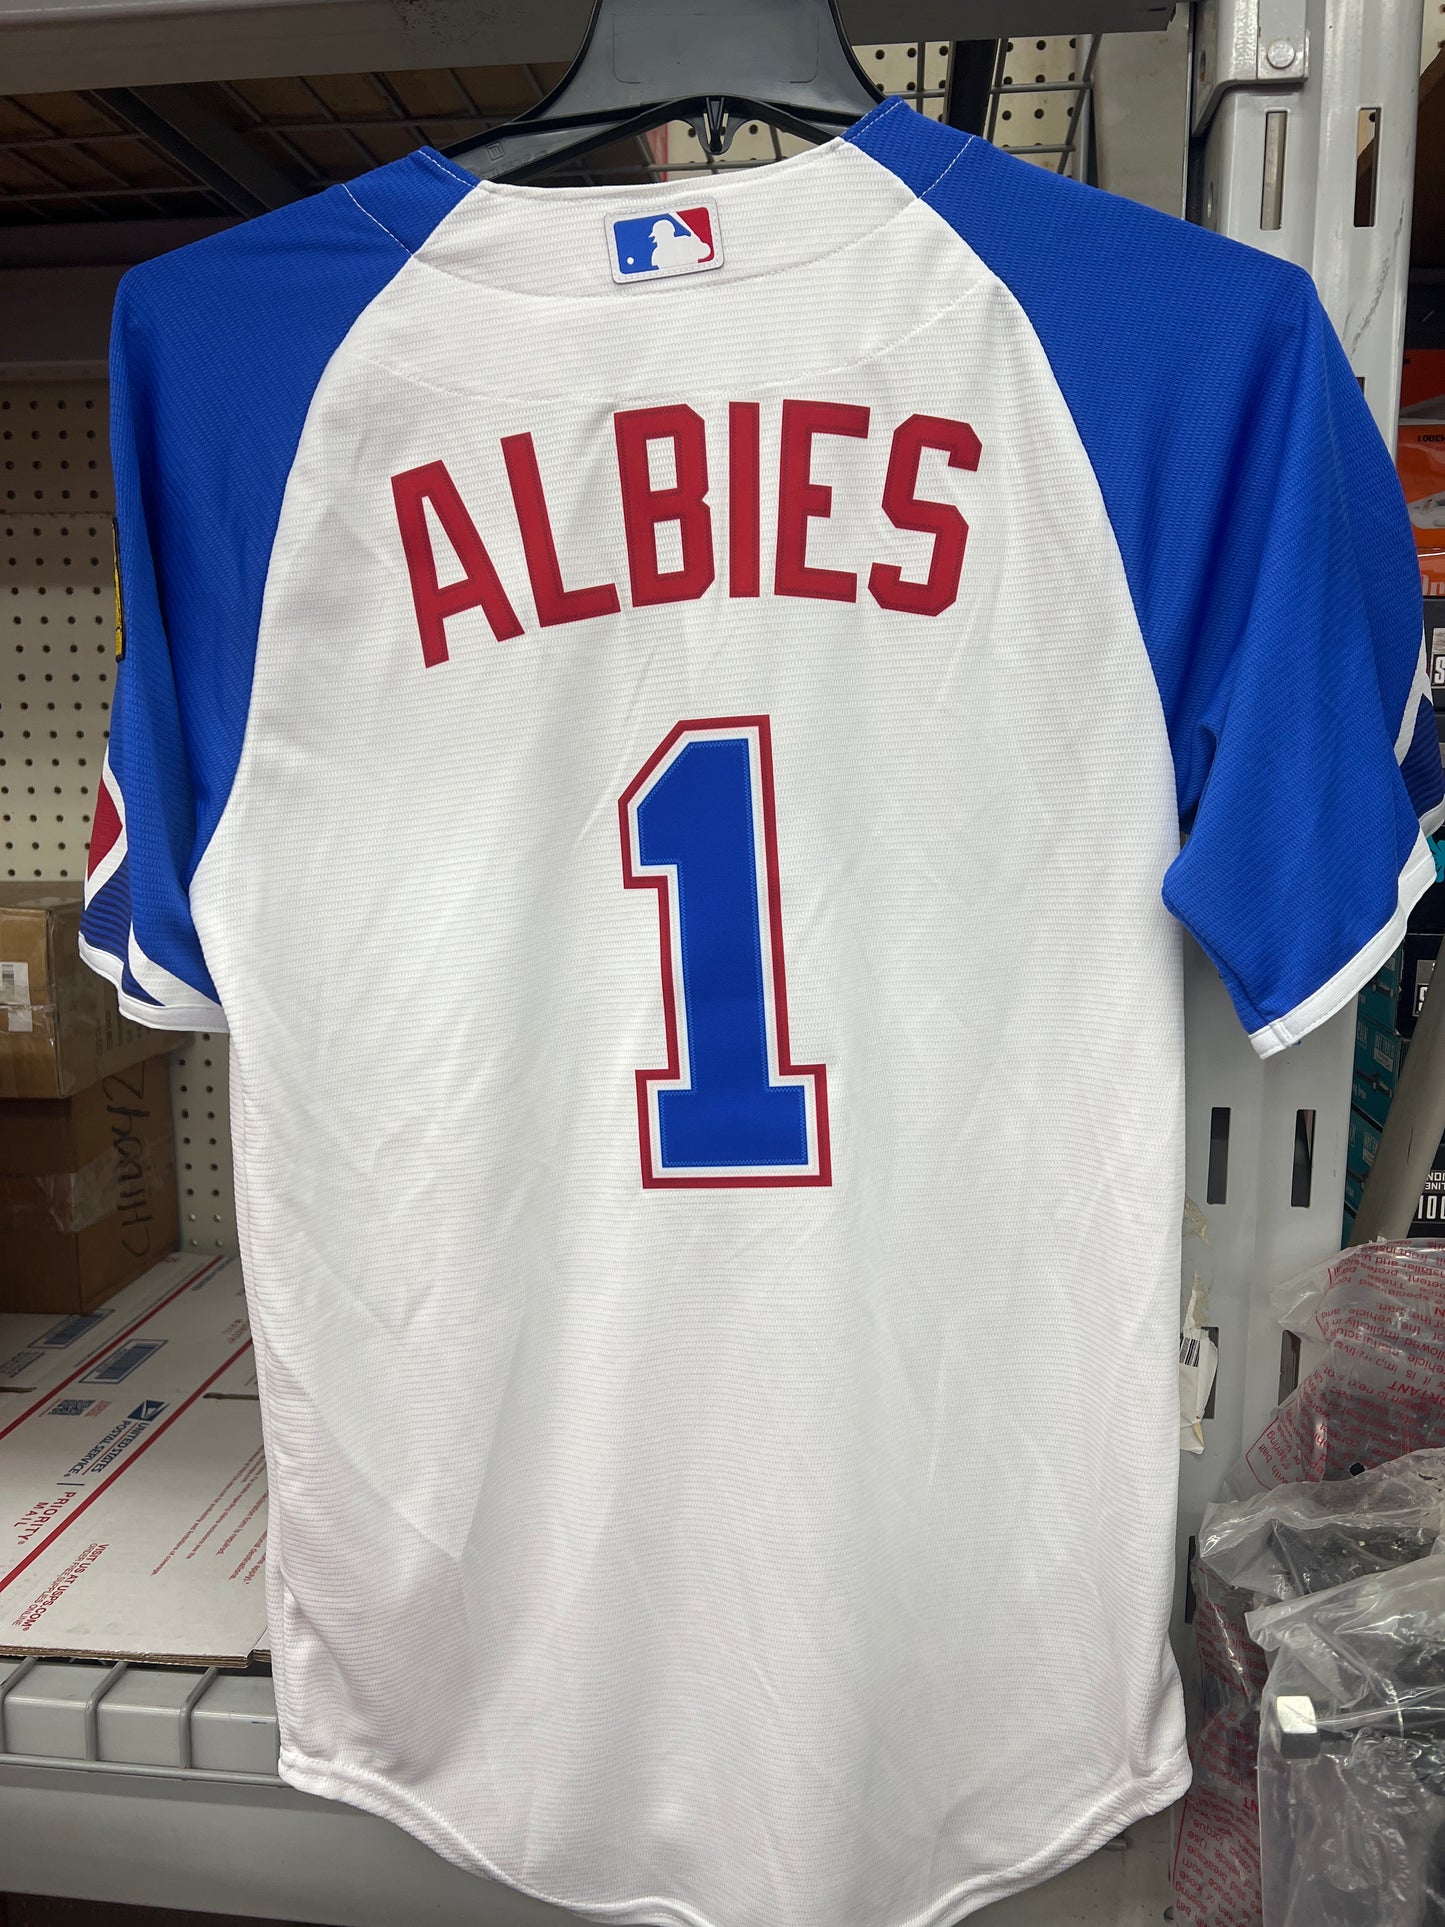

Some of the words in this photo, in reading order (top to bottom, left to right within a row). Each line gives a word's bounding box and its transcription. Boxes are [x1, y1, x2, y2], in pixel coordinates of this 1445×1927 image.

[391, 399, 982, 668] ALBIES
[618, 715, 832, 1188] 1
[98, 1420, 131, 1445] POSTAL
[117, 1422, 150, 1448] UNITED
[90, 1447, 124, 1473] STATES
[13, 1502, 49, 1527] MAIL
[86, 1543, 110, 1562] VISIT
[64, 1574, 78, 1585] AT
[74, 1562, 91, 1574] US
